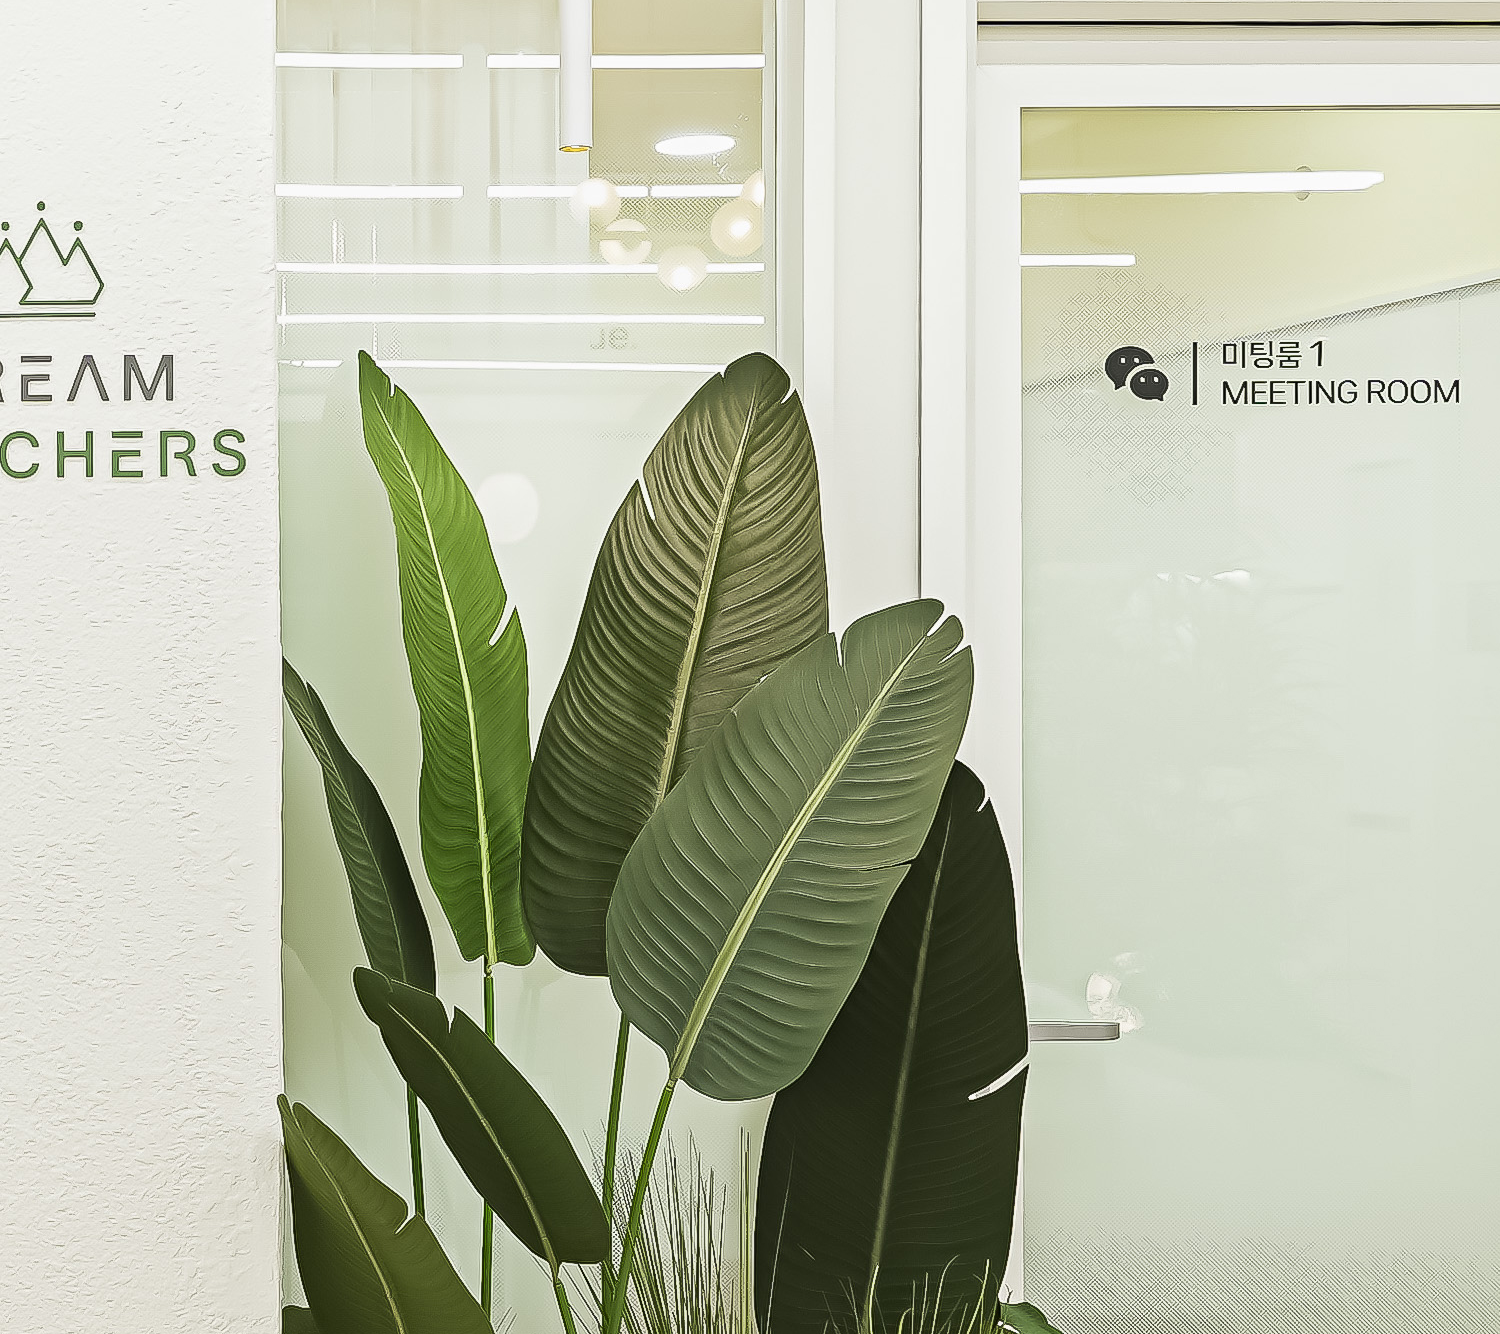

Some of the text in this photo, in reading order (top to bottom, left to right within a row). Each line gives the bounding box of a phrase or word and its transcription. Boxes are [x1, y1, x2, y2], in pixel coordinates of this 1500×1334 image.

[1222, 340, 1323, 369] 미팅룸 1
[1222, 379, 1460, 405] MEETING ROOM
